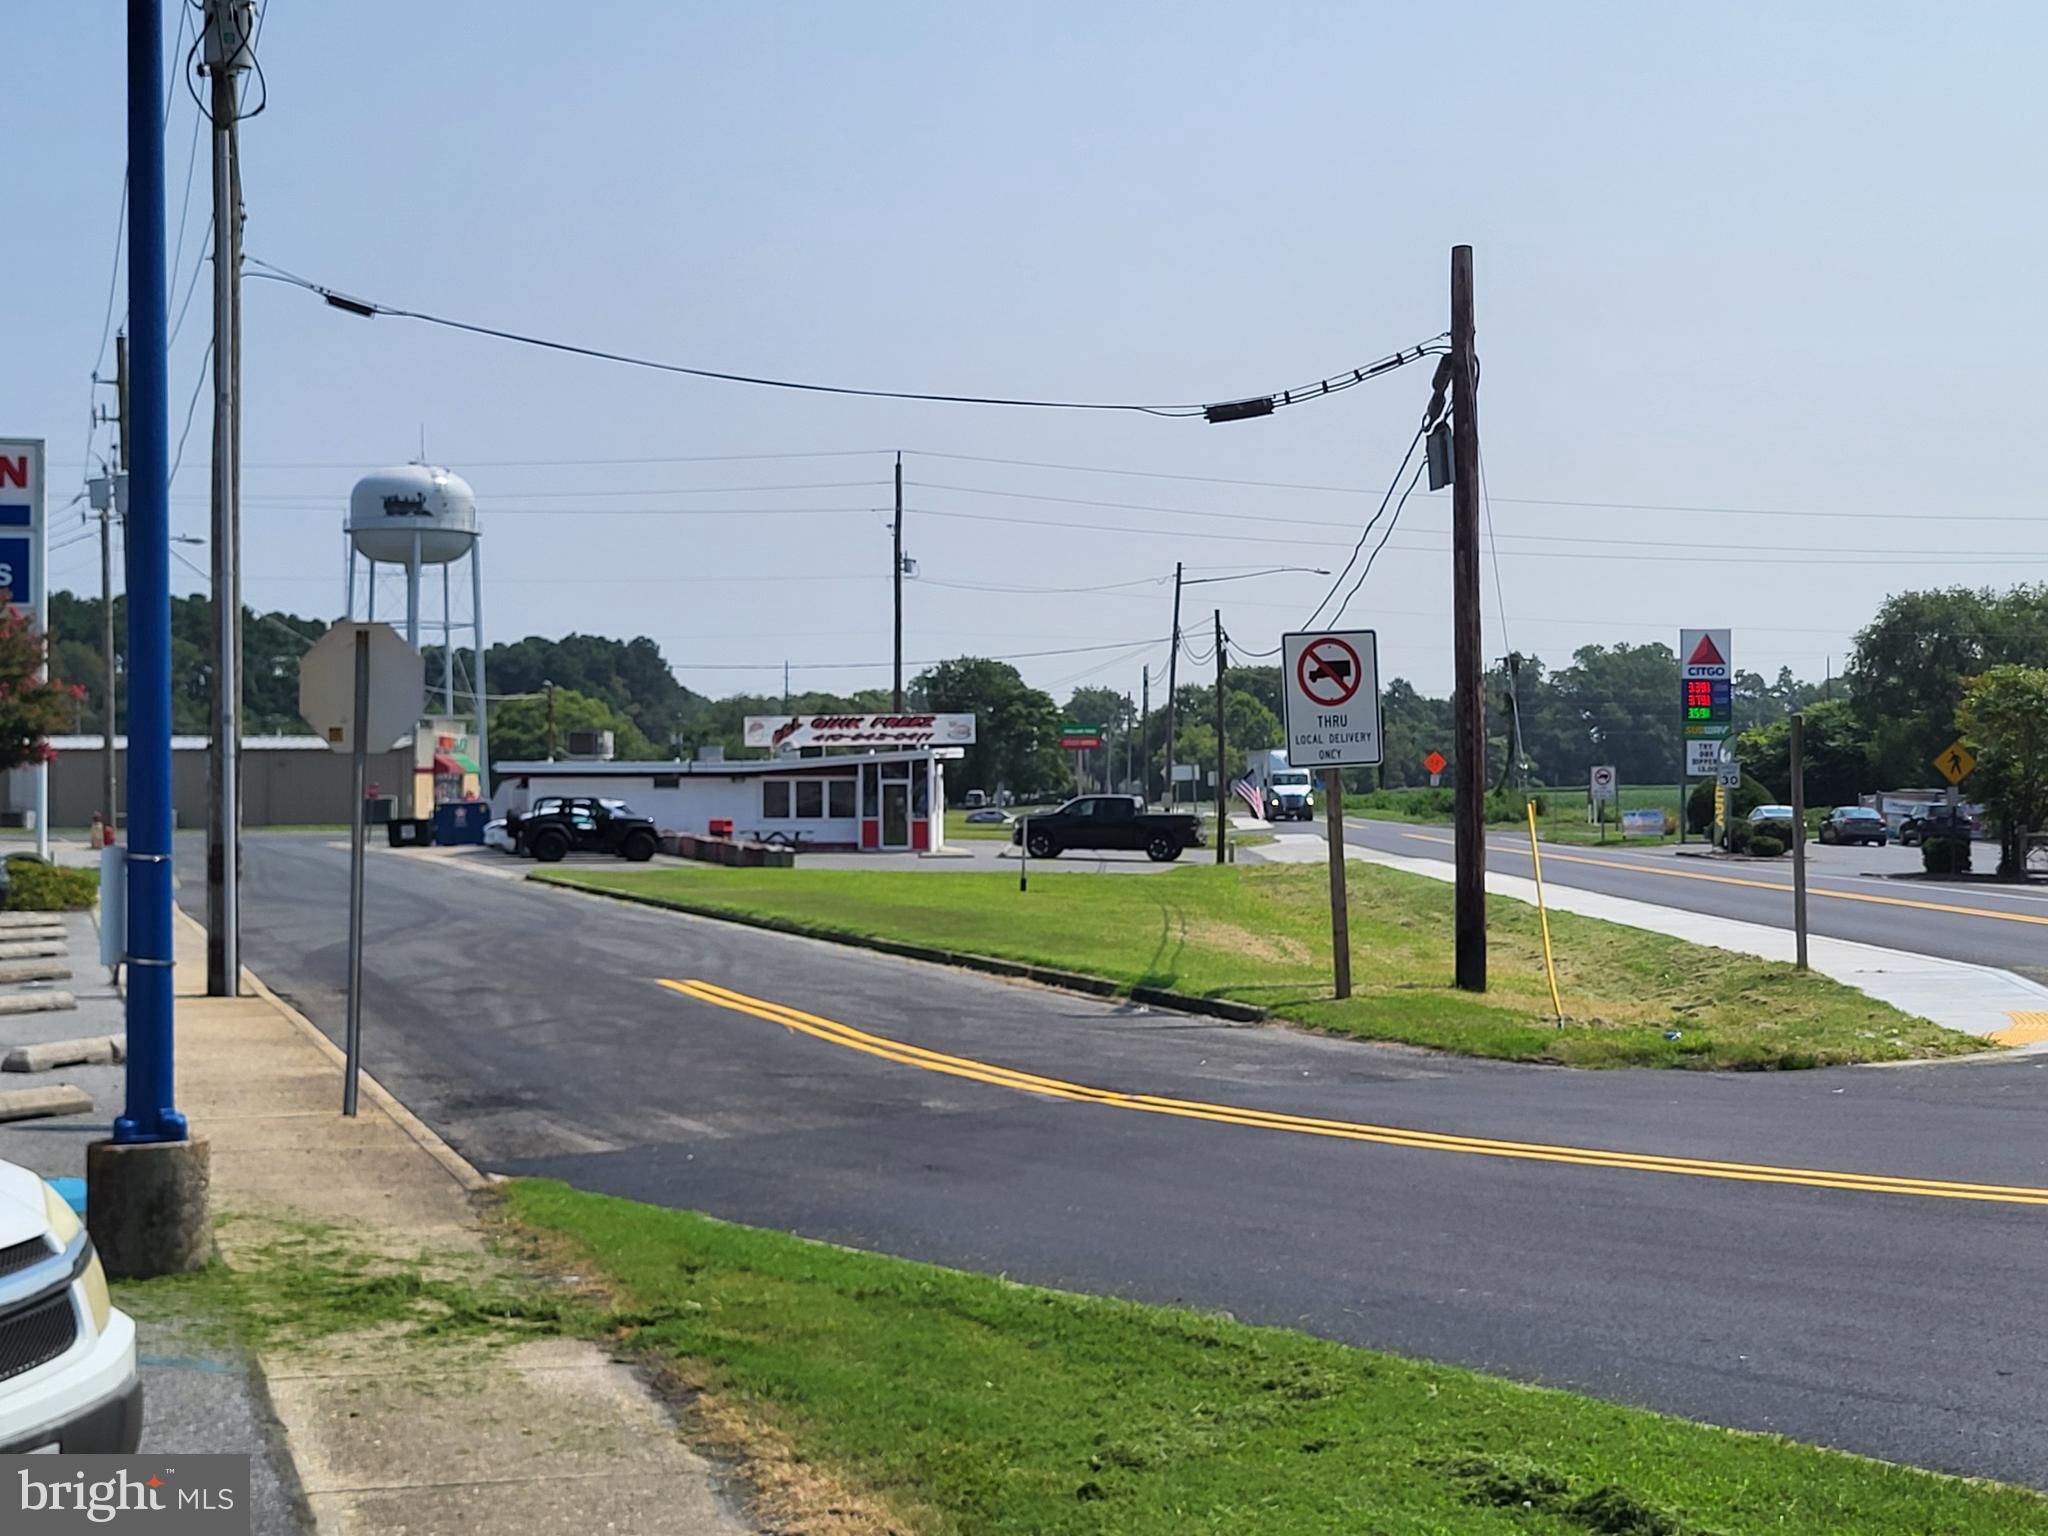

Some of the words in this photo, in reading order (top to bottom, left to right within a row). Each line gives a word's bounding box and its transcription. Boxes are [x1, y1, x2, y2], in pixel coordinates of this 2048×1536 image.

[1688, 667, 1725, 676] CITGO
[1317, 714, 1348, 728] THRU
[1684, 725, 1729, 735] SUBWAY
[1295, 733, 1323, 745] LOCAL
[1329, 731, 1371, 744] DELIVERY
[1721, 775, 1738, 786] 30
